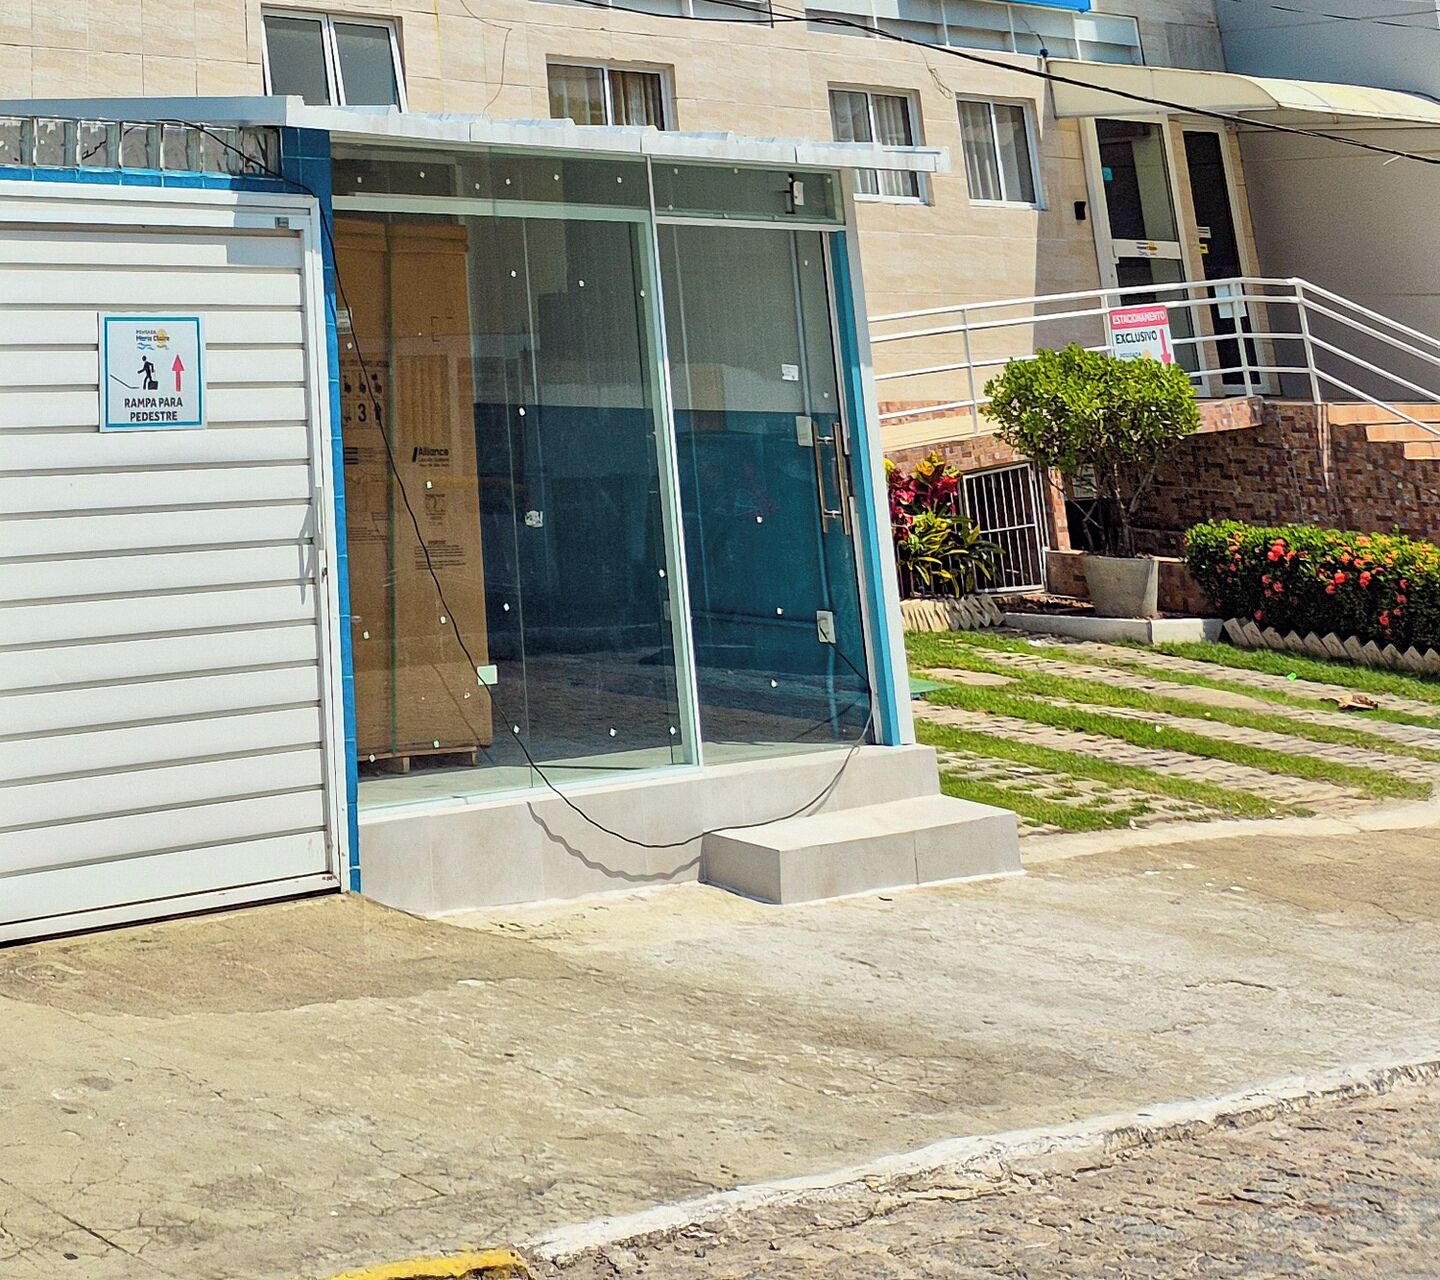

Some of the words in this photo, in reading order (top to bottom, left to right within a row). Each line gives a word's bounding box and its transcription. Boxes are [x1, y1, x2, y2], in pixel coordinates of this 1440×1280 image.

[1112, 310, 1165, 325] ESTACIONAMENTO
[1115, 330, 1158, 344] EXCLUSIVO
[124, 398, 157, 408] RAMPA
[158, 397, 183, 408] PARA
[130, 411, 178, 422] PEDESTRE
